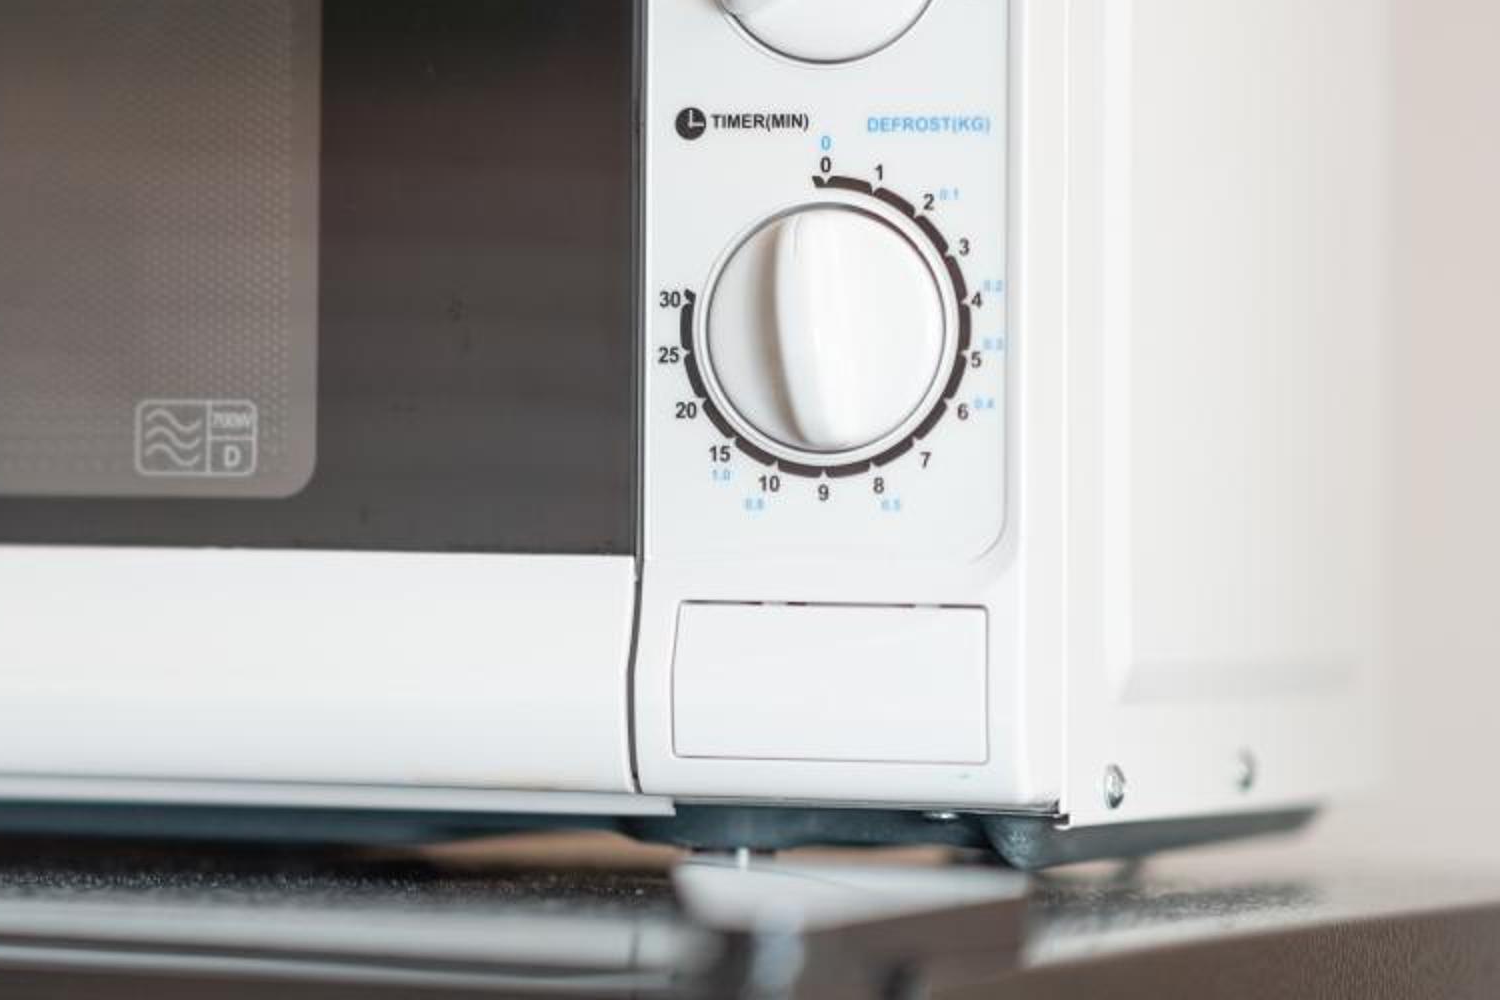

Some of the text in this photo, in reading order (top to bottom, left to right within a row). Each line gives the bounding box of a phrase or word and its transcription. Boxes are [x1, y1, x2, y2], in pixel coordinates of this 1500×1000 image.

[711, 112, 810, 132] TIMER(MIN)
[866, 116, 991, 134] DEFROST(KG)
[820, 135, 832, 151] 0
[819, 156, 833, 173] 0
[874, 164, 884, 180] 1
[922, 193, 935, 211] 2
[958, 237, 971, 256] 3
[659, 290, 682, 307] 30
[971, 291, 983, 309] 4
[657, 346, 680, 364] 25
[971, 351, 982, 368] 5
[675, 401, 698, 419] 20
[957, 402, 969, 420] 6
[223, 444, 241, 468] D
[709, 445, 731, 463] 15
[920, 451, 932, 469] 7
[758, 475, 781, 493] 10
[817, 484, 830, 502] 9
[873, 477, 885, 494] 8
